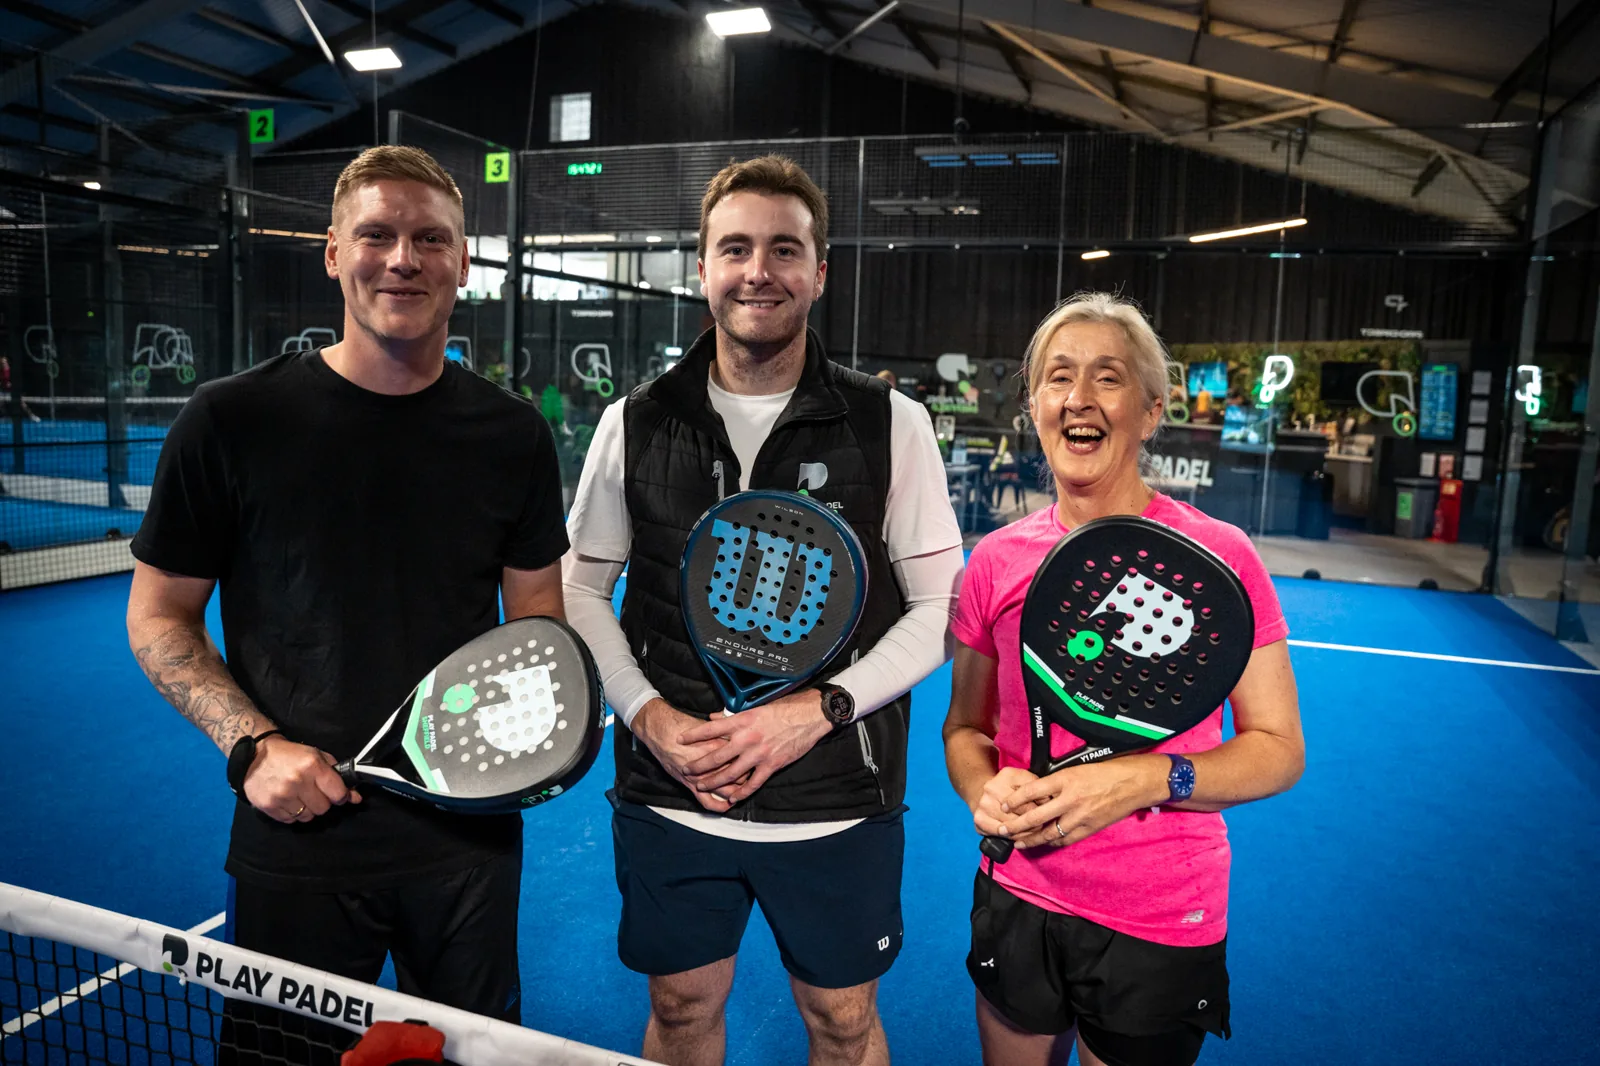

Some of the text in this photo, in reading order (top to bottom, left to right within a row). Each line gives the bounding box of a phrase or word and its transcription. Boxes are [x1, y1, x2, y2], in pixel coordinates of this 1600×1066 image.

[256, 115, 269, 138] 2
[492, 159, 503, 177] 3
[1151, 454, 1213, 487] PADEL
[716, 637, 765, 656] ENDURE
[767, 652, 789, 663] PRO
[1075, 691, 1105, 711] PLAY PADEL
[427, 714, 437, 752] PLAY PADEL
[1033, 706, 1044, 738] Y1 PADEL
[1080, 747, 1114, 763] Y1 PADEL
[195, 951, 375, 1028] PLAY PADEL
